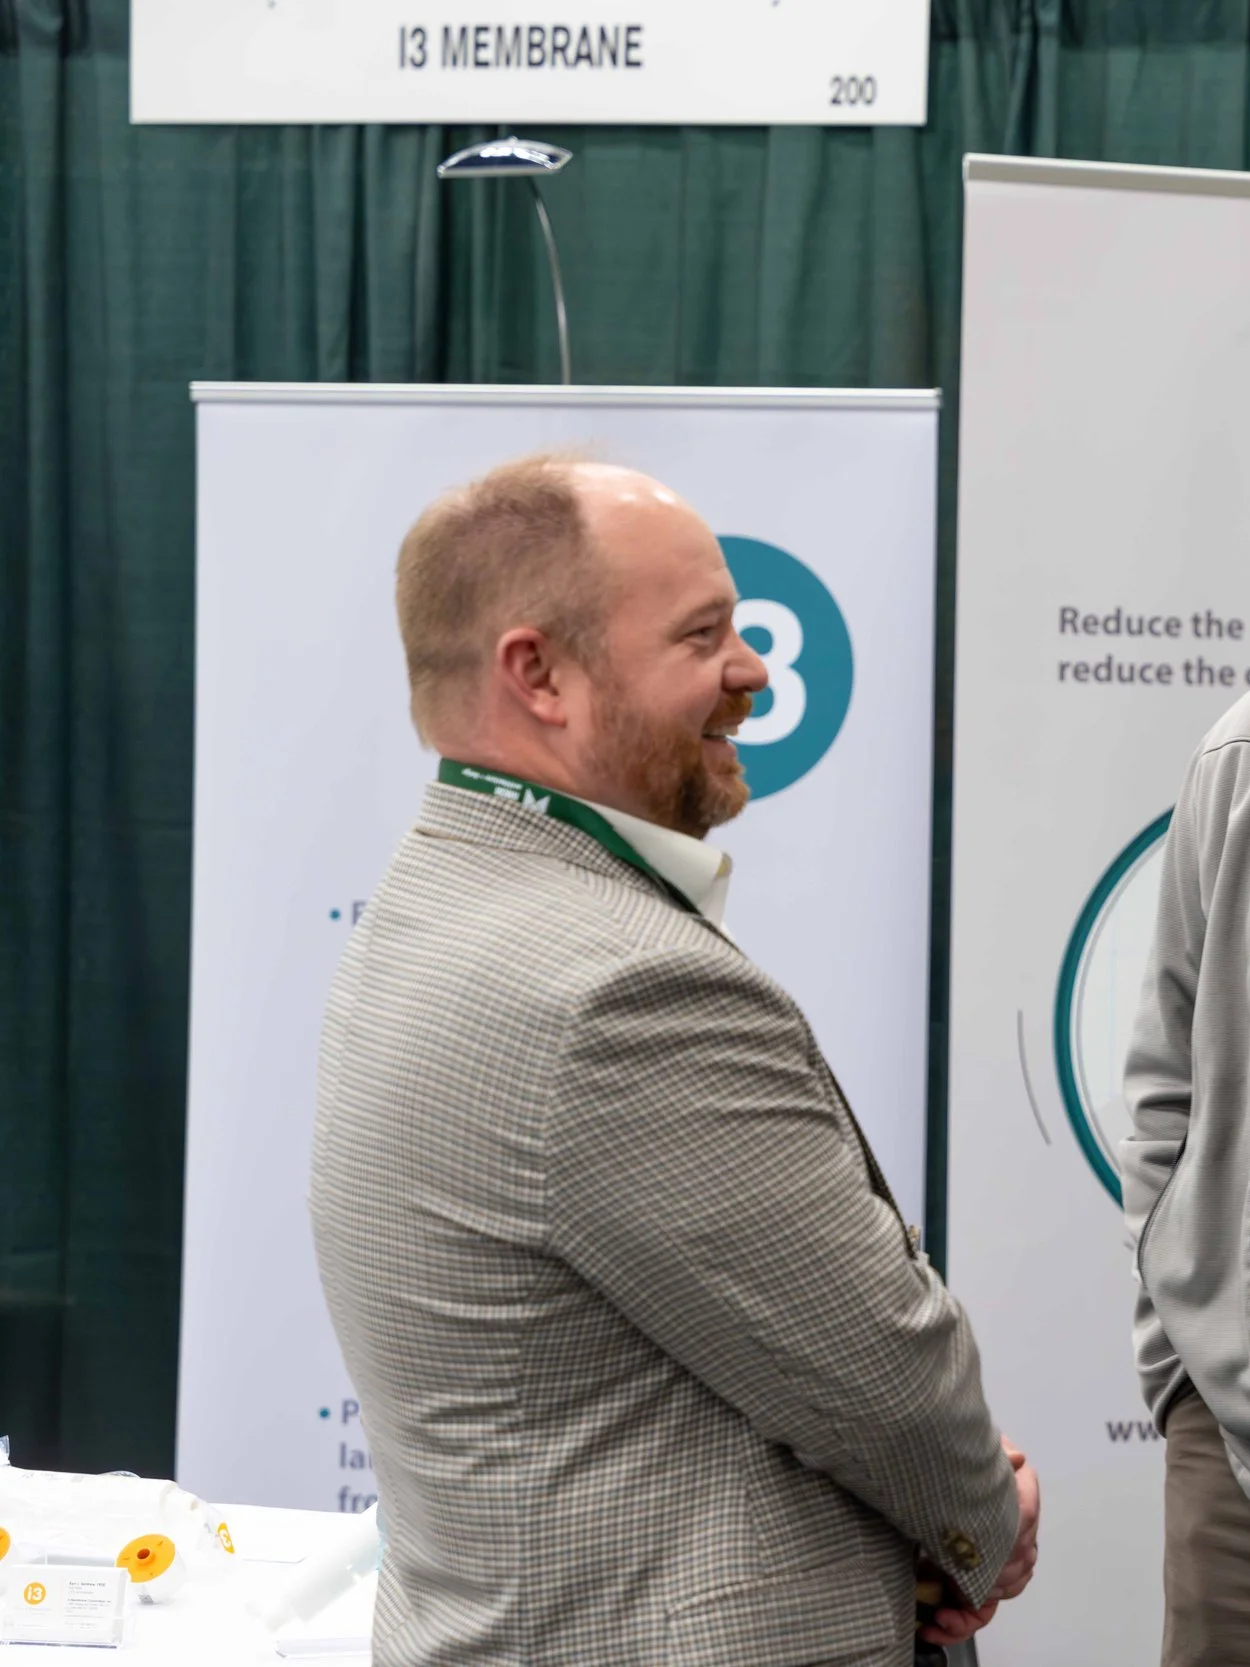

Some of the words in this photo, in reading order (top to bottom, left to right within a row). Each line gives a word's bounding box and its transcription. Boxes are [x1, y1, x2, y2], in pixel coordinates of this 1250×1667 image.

[399, 25, 427, 69] I3
[441, 25, 643, 69] MEMBRANE
[829, 77, 877, 106] 200
[1058, 606, 1183, 638] Reduce
[1192, 611, 1244, 639] the
[1057, 655, 1174, 684] reduce
[1184, 657, 1236, 686] the
